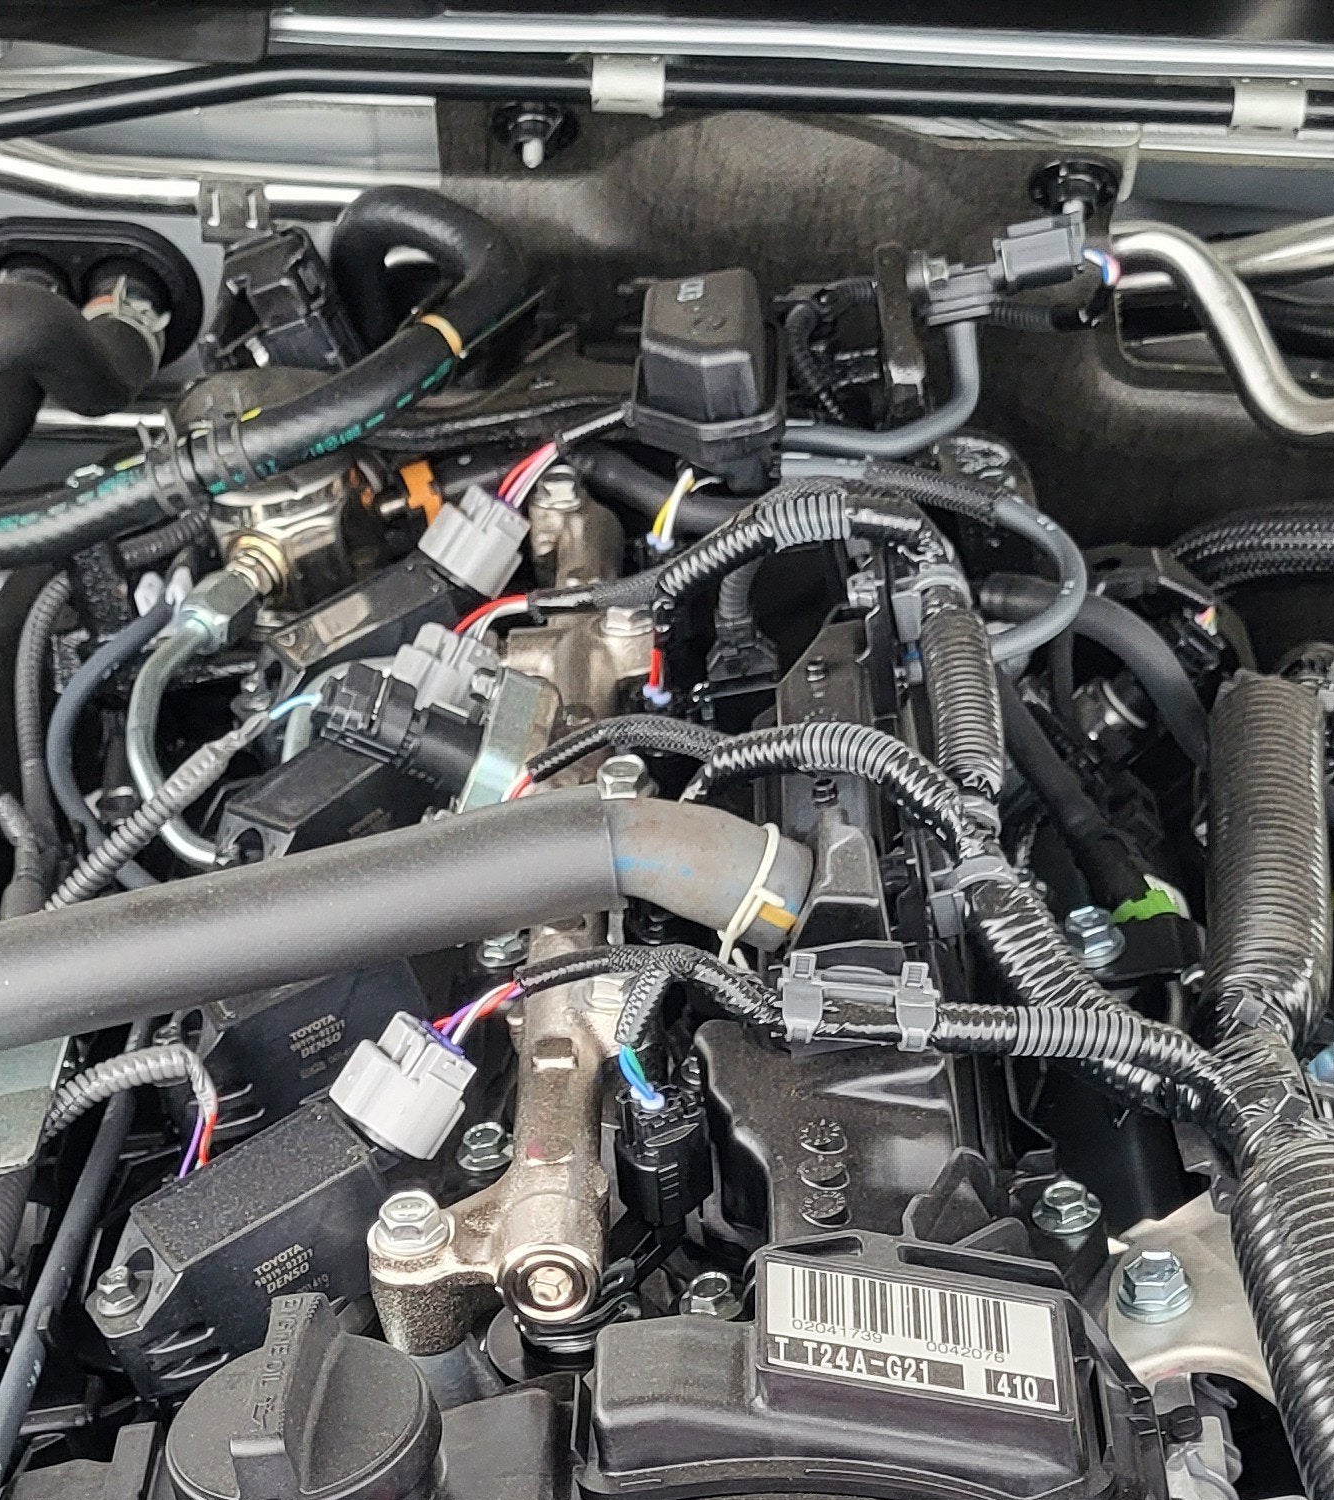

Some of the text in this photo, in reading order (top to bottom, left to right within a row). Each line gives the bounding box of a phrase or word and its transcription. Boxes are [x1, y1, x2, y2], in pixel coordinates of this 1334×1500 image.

[288, 1013, 336, 1041] TOYOTA
[300, 1032, 342, 1058] DENSO
[252, 1243, 304, 1276] TOYOTA
[266, 1261, 310, 1294] DENSO
[791, 1318, 884, 1345] 02041739
[925, 1340, 1006, 1364] 0042076
[773, 1335, 1039, 1402] T T24A-G21 410
